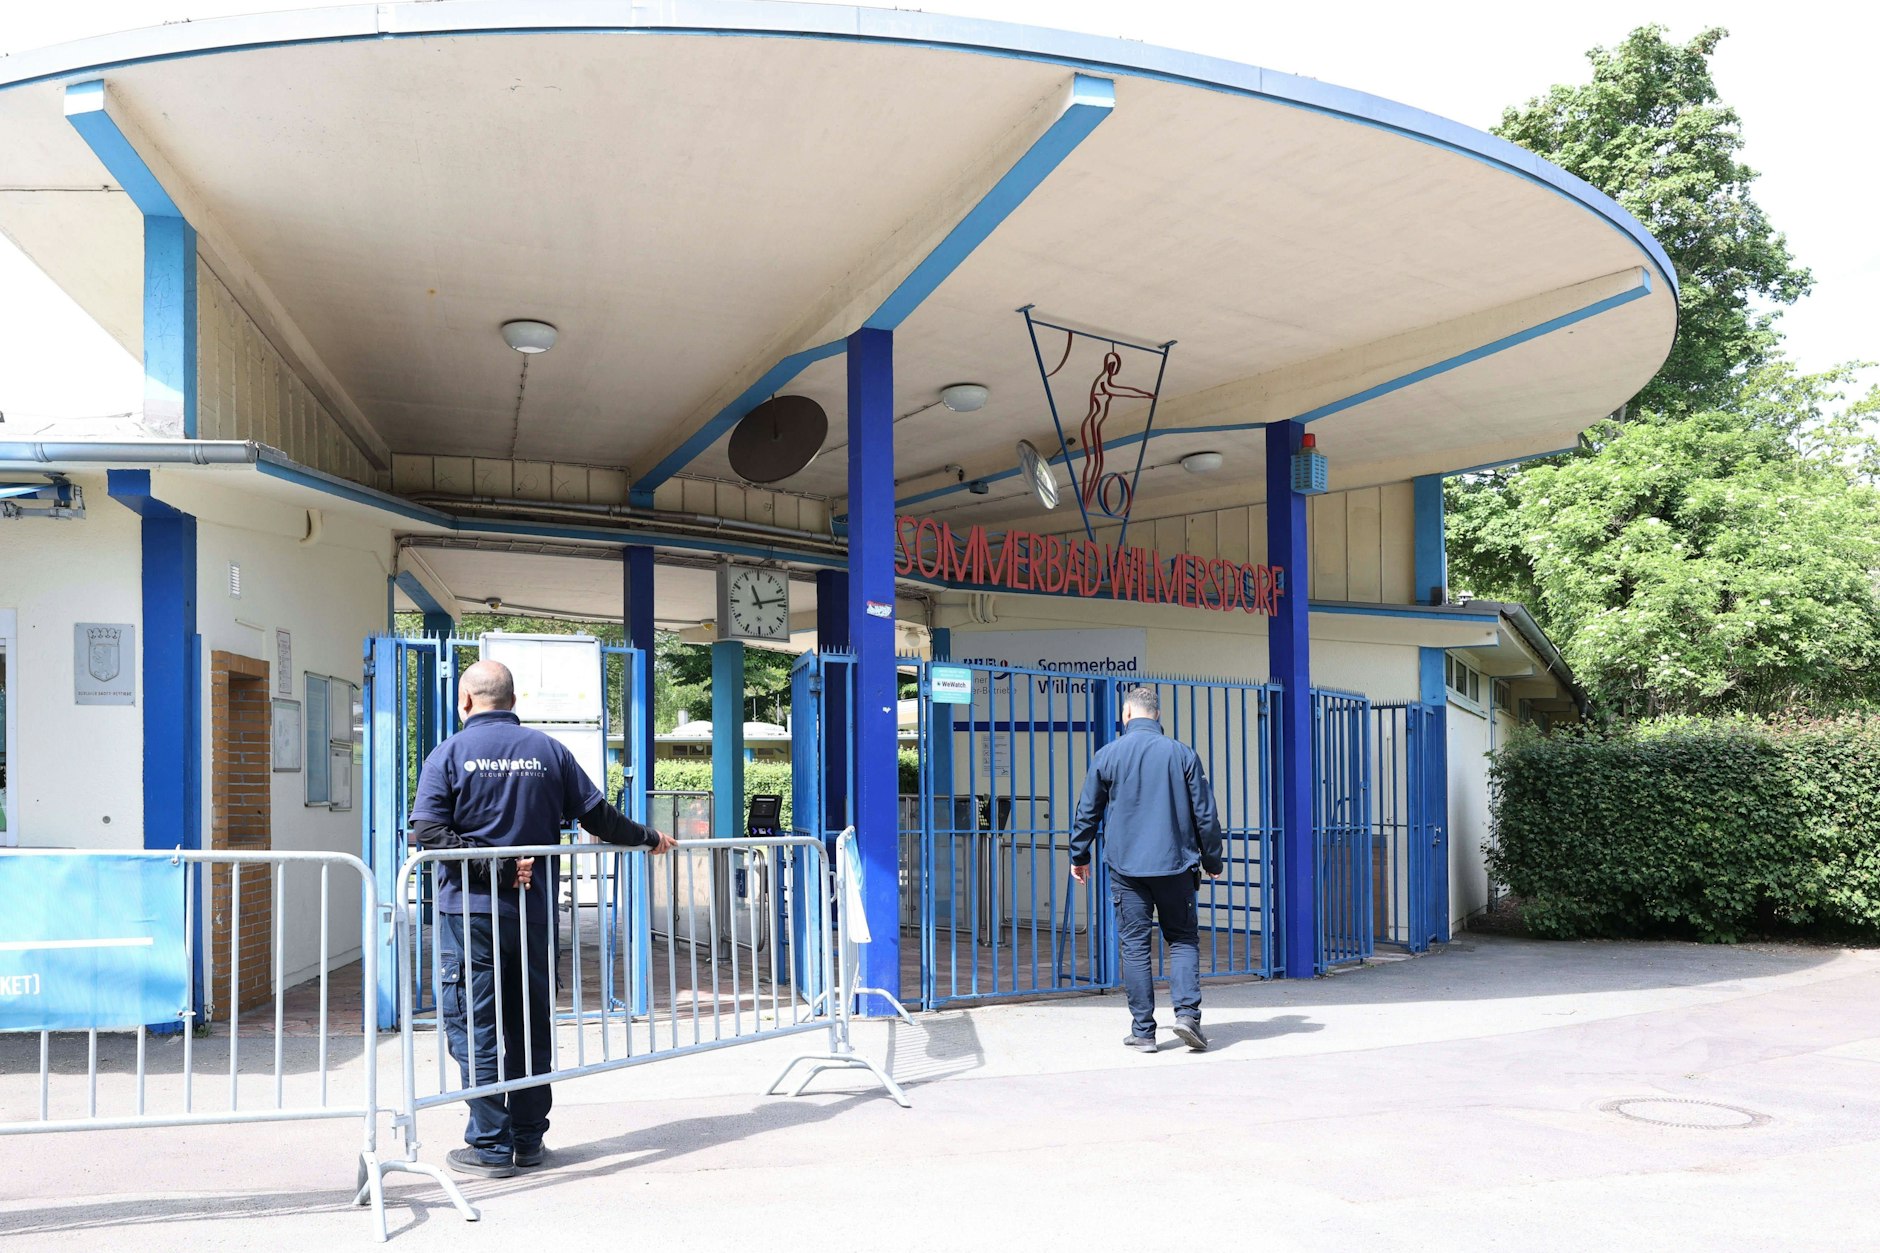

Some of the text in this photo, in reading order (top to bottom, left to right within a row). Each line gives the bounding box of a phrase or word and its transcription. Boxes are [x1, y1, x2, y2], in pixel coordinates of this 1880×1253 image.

[895, 515, 1284, 618] SOMMERBAD WILMERSDORF
[1037, 656, 1137, 673] Sommerbad
[941, 680, 966, 689] WeWatch
